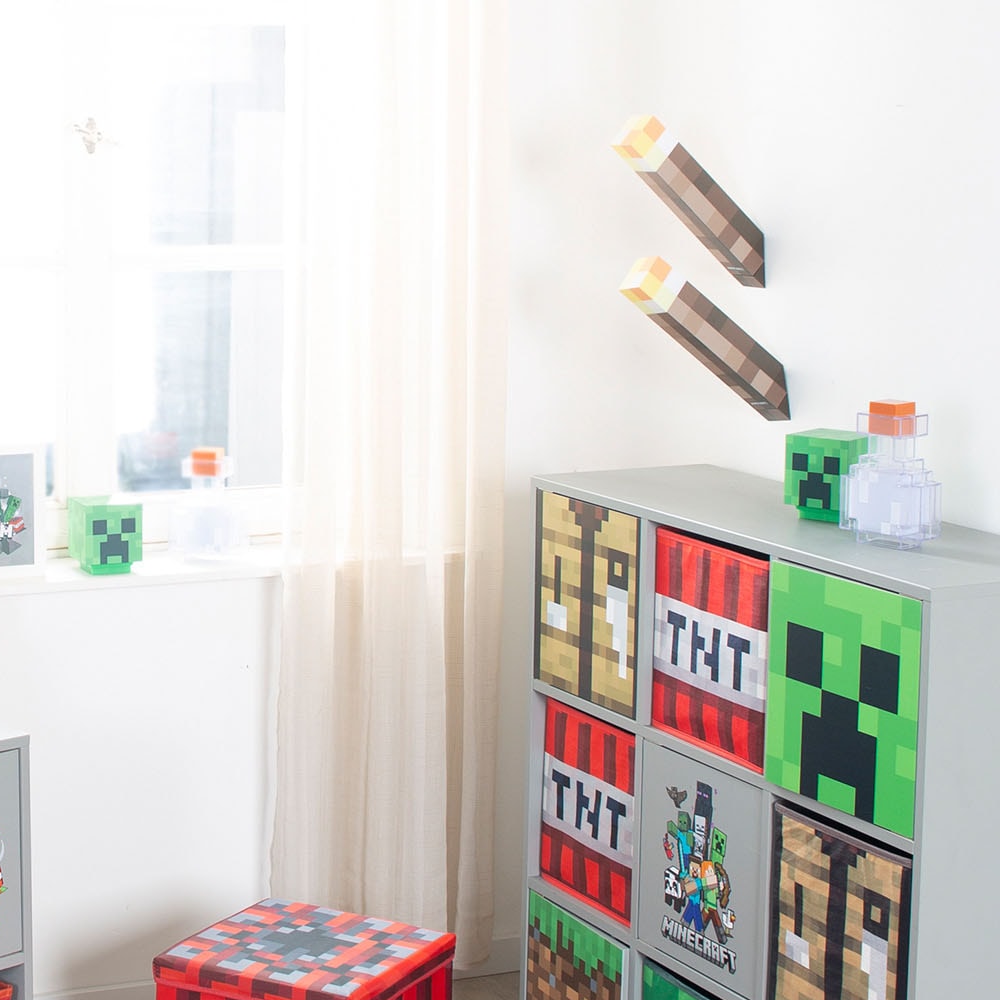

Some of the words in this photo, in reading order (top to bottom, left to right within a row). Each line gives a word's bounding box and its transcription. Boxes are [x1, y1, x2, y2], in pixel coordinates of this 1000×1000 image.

[667, 610, 750, 691] TNT
[551, 768, 627, 849] TNT
[661, 915, 737, 975] MINECRAFT
